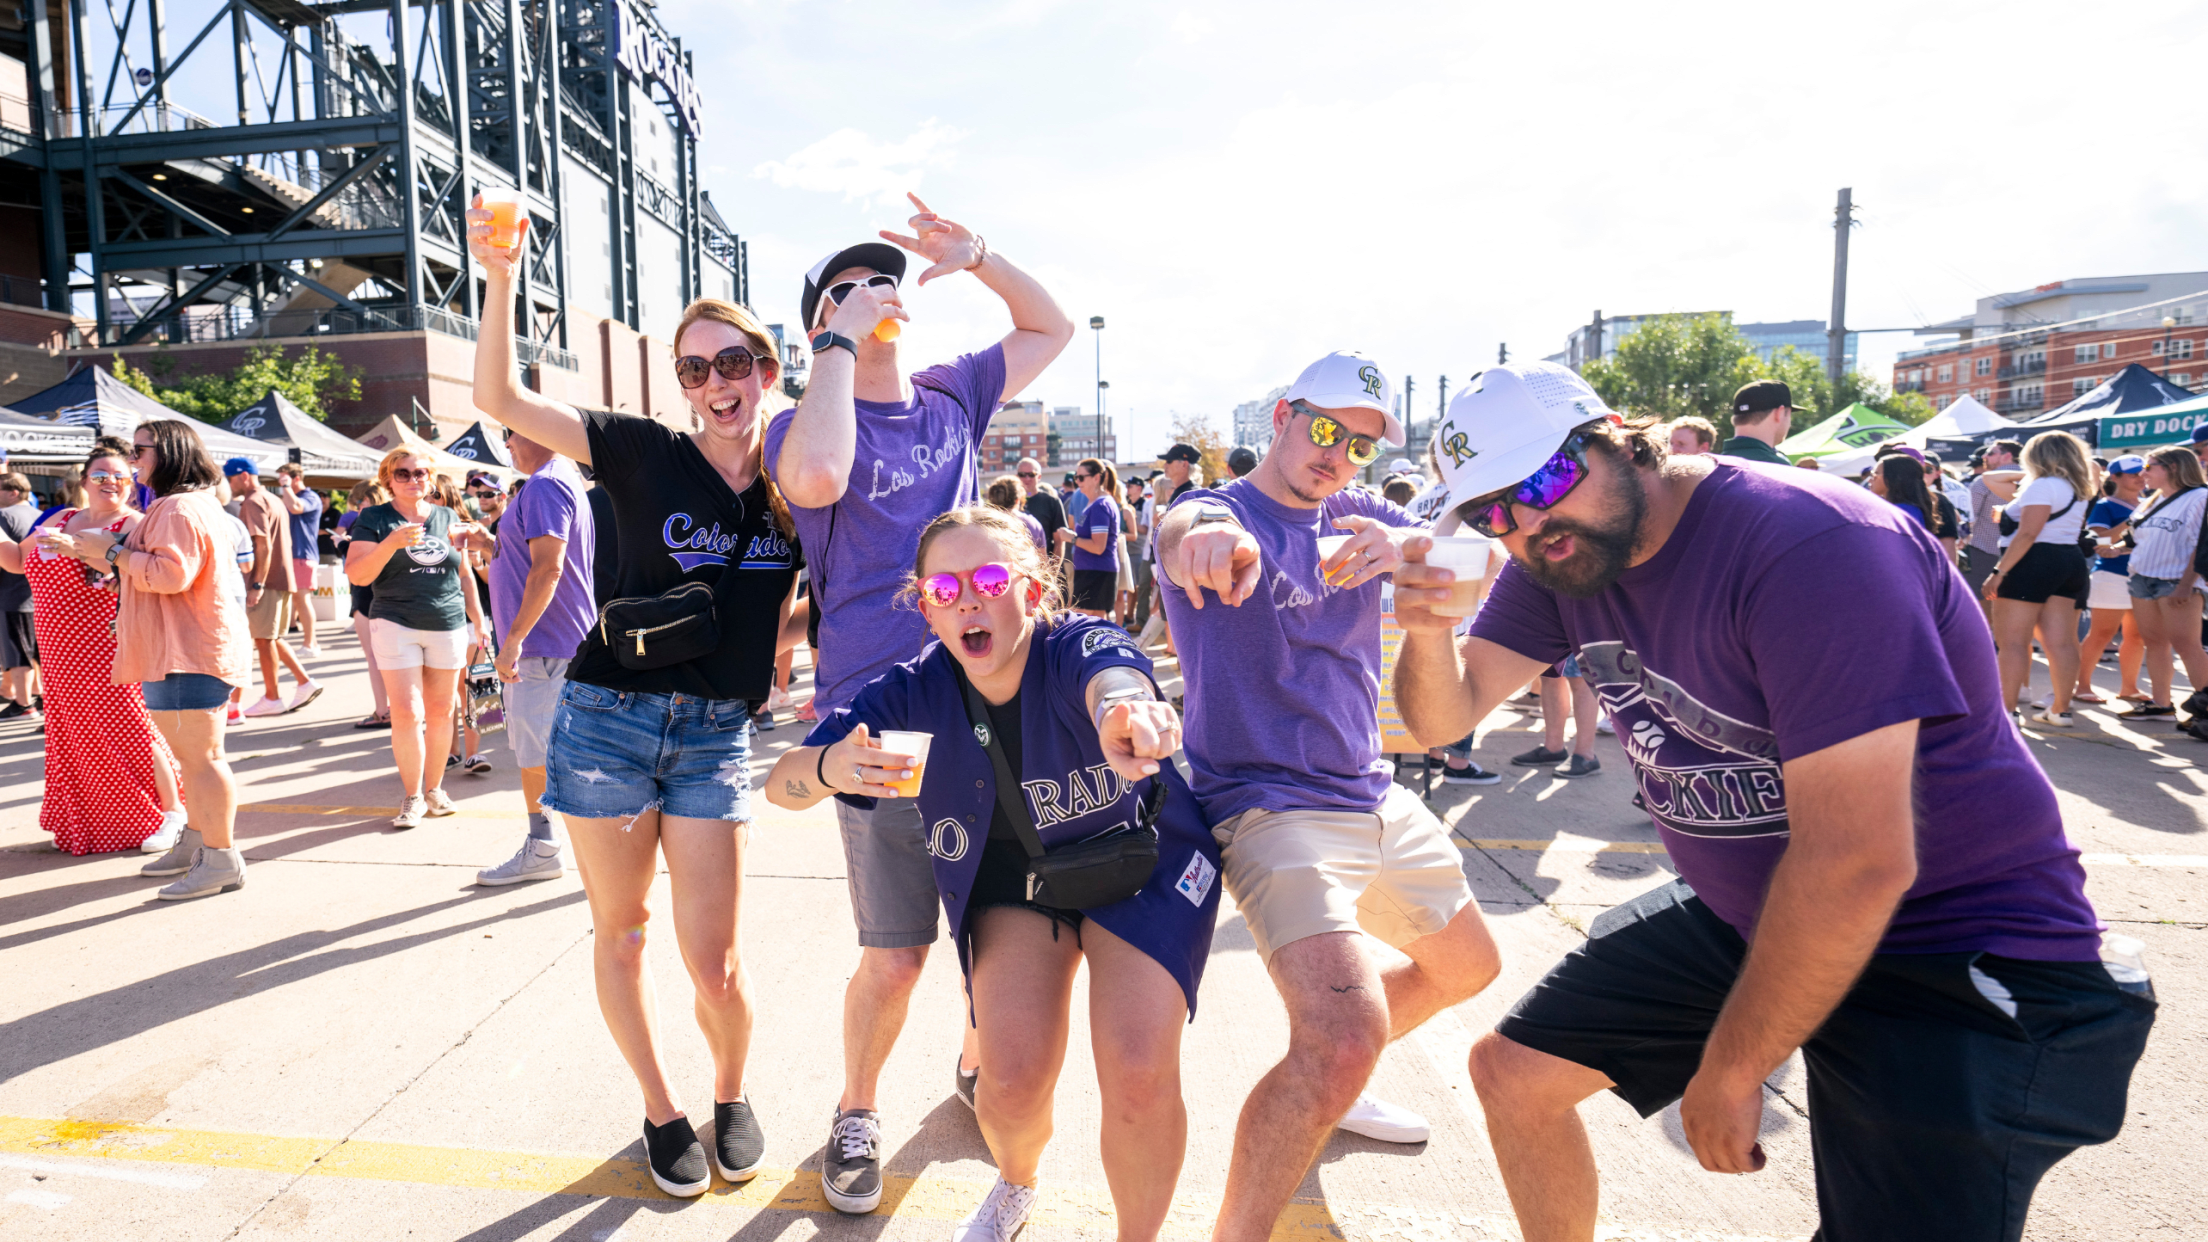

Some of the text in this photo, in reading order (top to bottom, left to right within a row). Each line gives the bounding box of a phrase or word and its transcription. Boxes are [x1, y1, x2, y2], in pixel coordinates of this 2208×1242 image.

[617, 0, 704, 141] ROCKIES
[2111, 421, 2148, 439] DRY
[868, 458, 915, 501] Los
